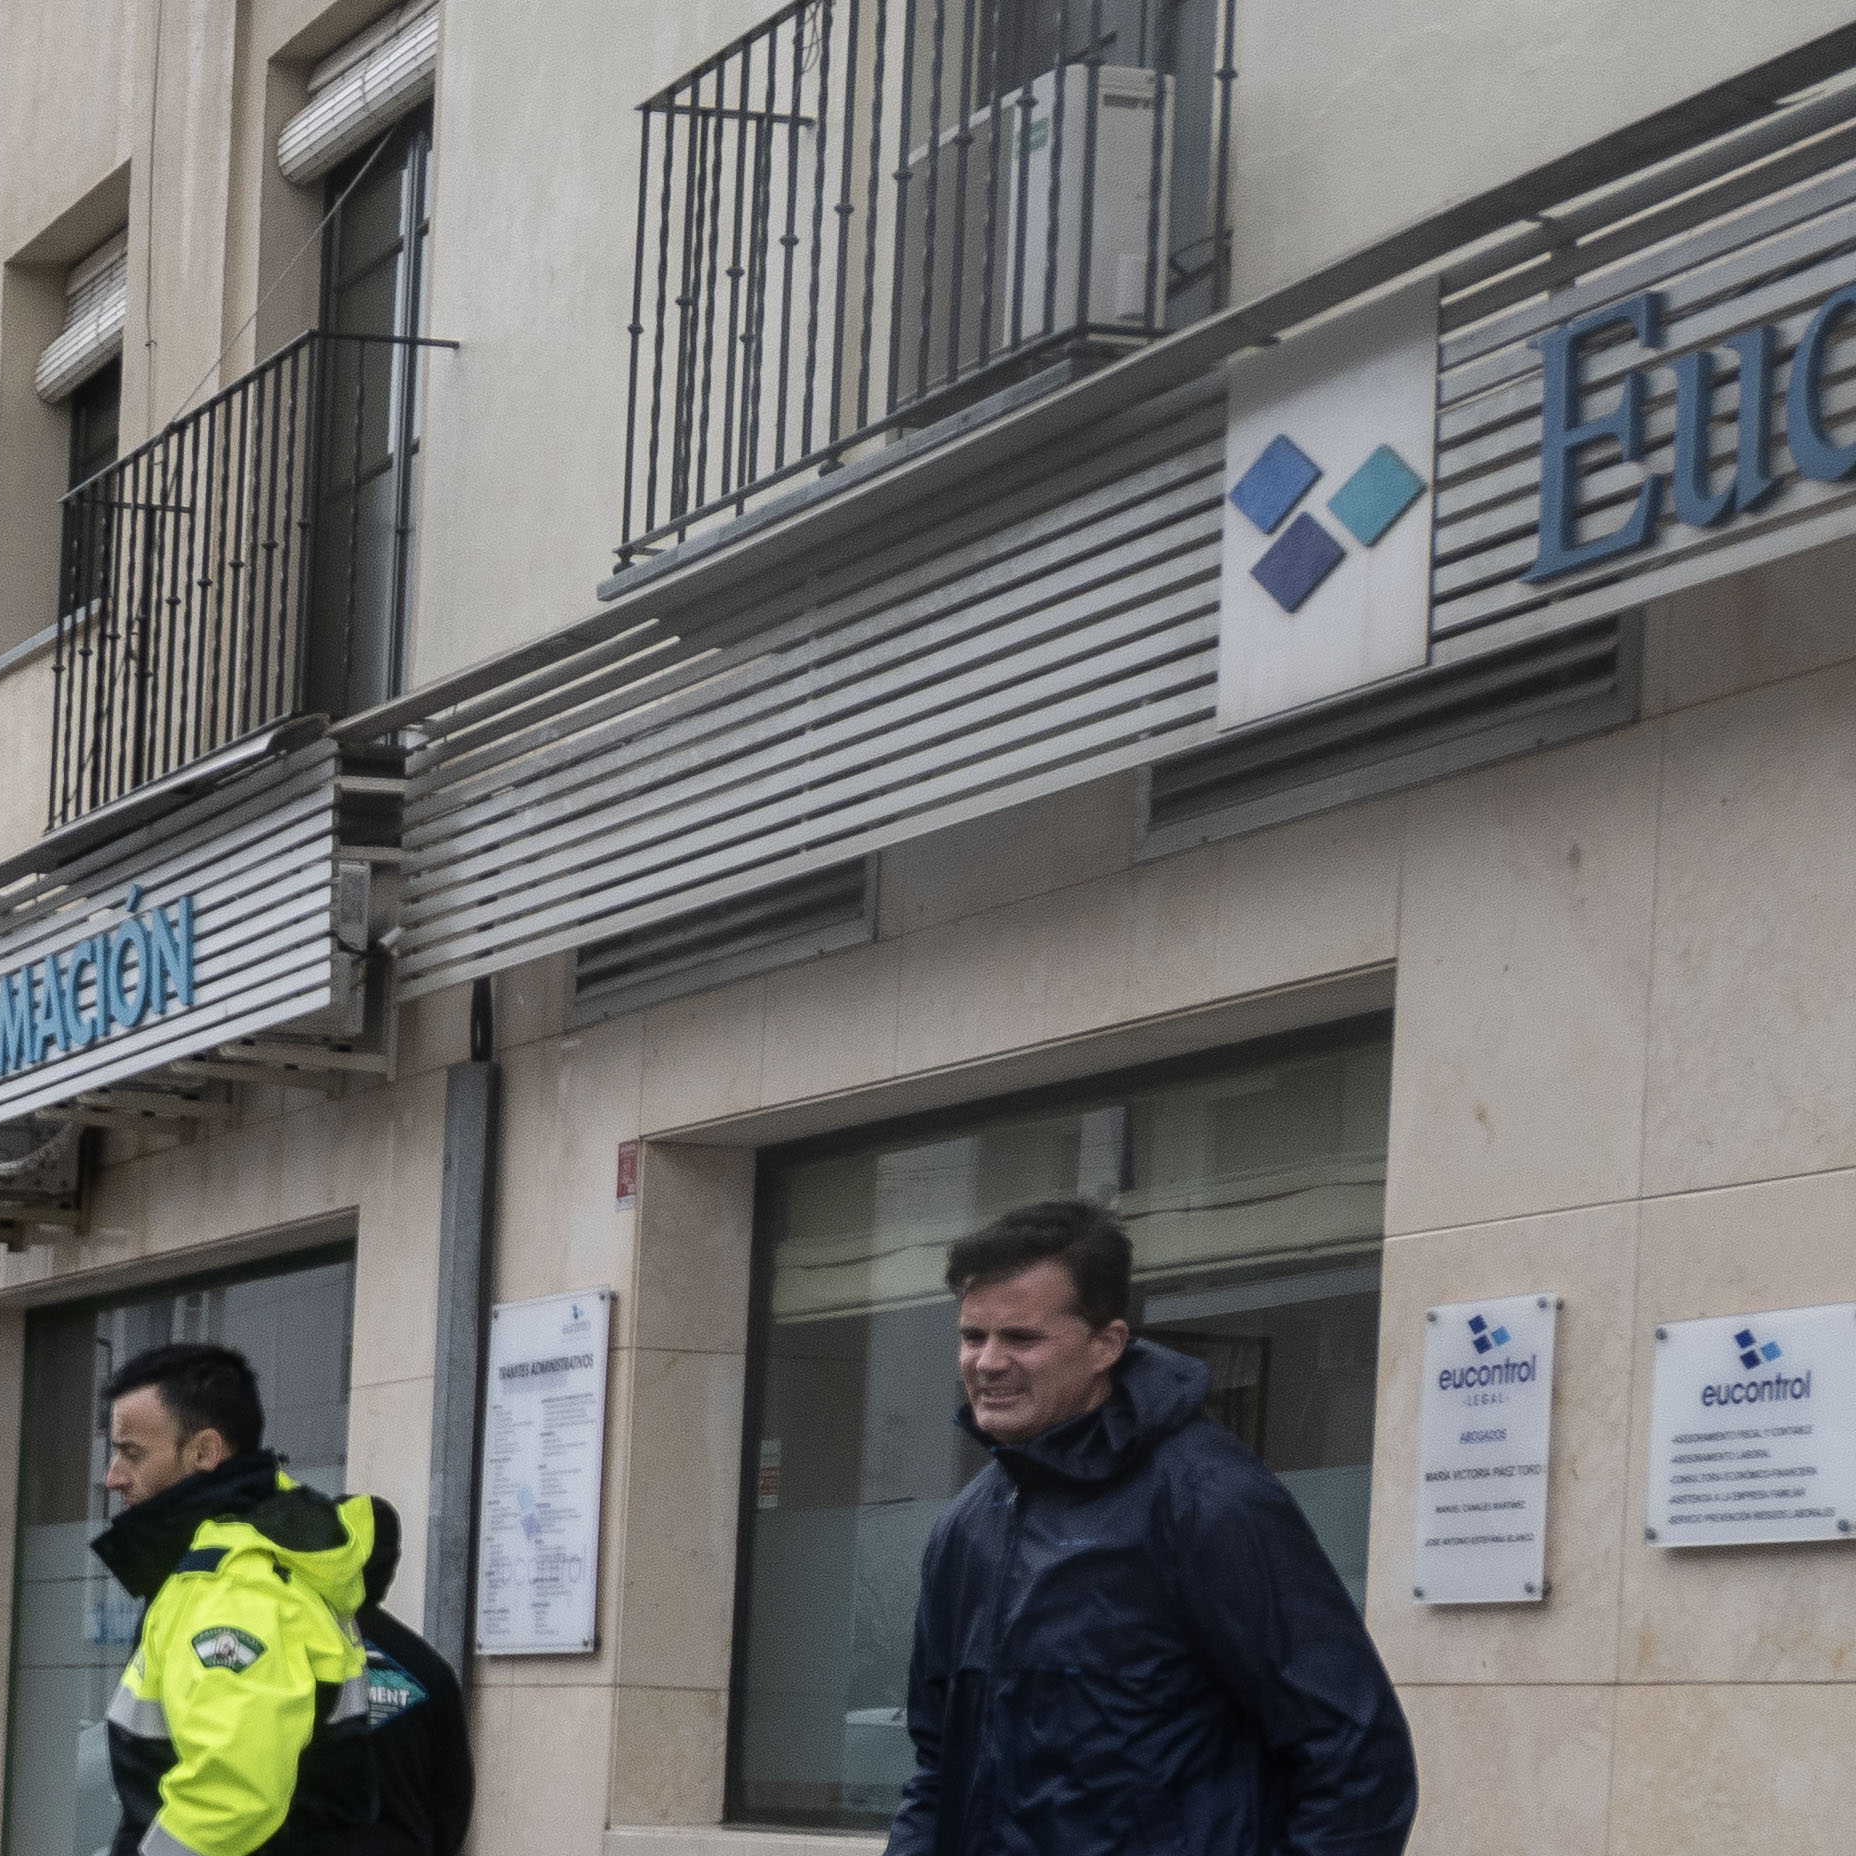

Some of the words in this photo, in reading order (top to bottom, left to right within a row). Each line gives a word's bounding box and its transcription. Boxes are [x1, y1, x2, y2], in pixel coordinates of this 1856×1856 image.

[1439, 1354, 1536, 1390] eucontrol
[1702, 1370, 1811, 1406] eucontrol
[1459, 1428, 1507, 1444] ABOGADOS
